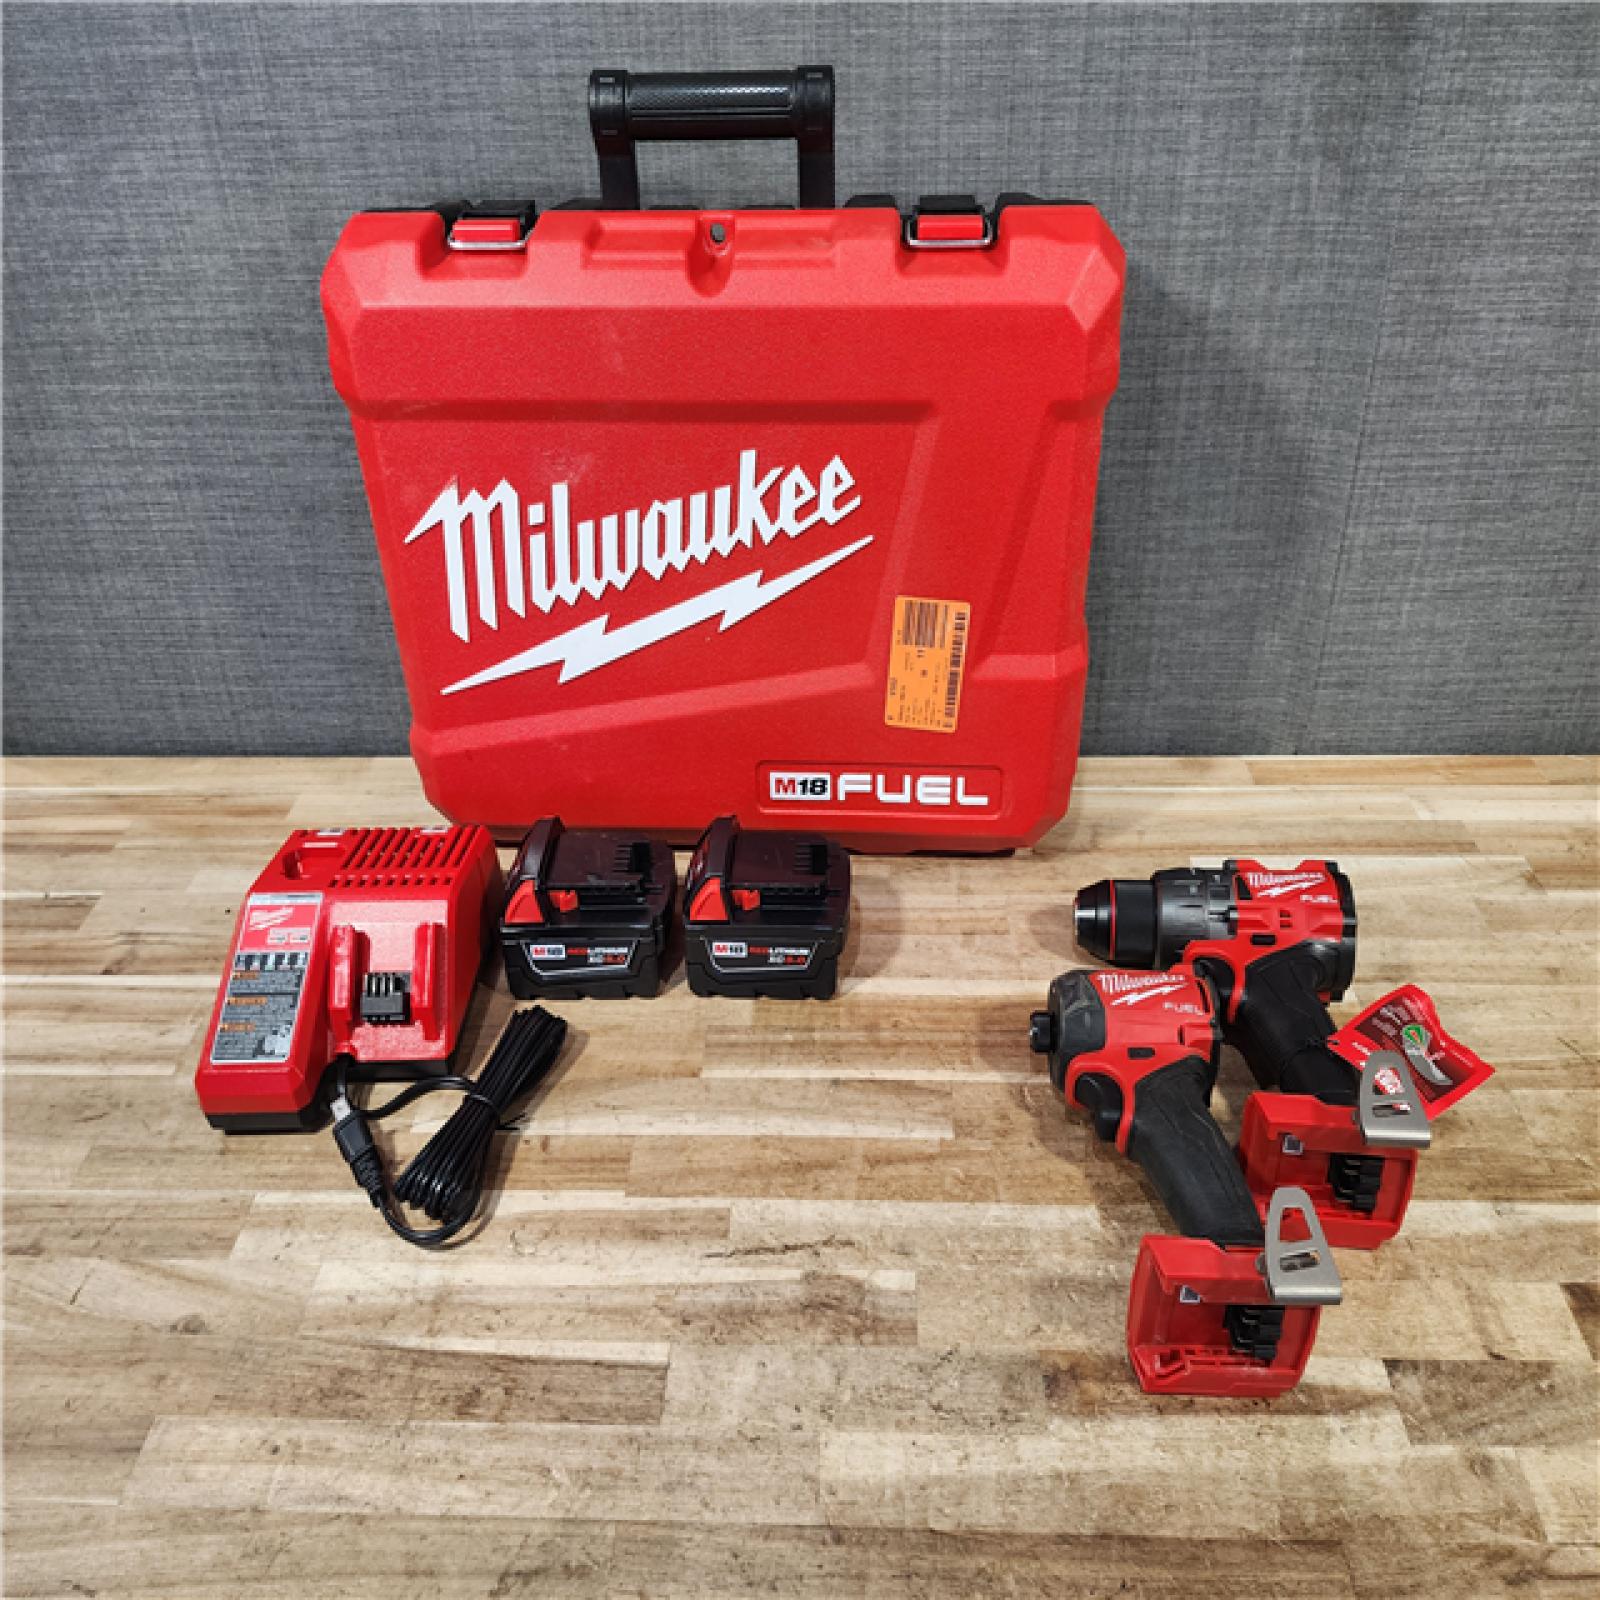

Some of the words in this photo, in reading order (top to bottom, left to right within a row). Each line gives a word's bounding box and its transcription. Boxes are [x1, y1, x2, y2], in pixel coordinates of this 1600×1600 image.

[404, 449, 862, 642] Milwaukee
[773, 776, 829, 797] M18
[837, 773, 989, 806] FUEL
